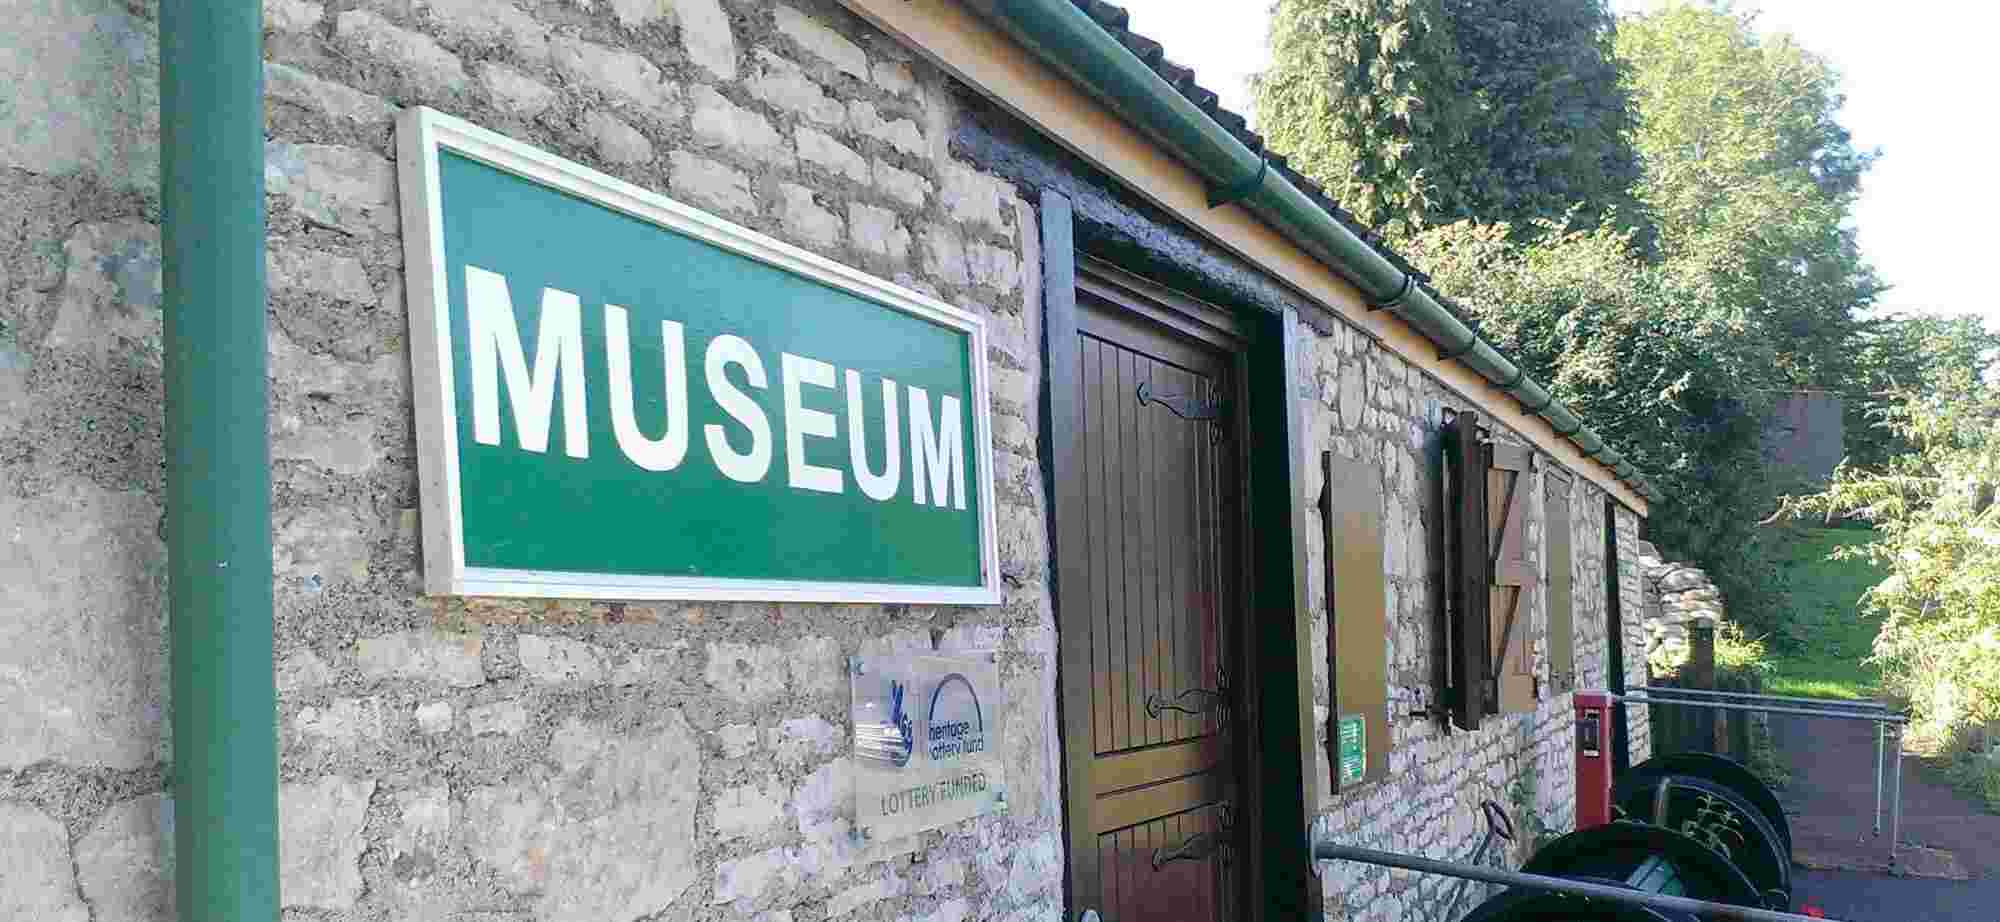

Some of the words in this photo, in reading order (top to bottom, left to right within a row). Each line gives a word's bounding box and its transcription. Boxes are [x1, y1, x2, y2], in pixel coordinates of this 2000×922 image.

[465, 264, 968, 510] MUSEUM
[963, 734, 985, 754] fund
[881, 785, 936, 816] LOTTERY
[937, 773, 987, 800] FUNDED
